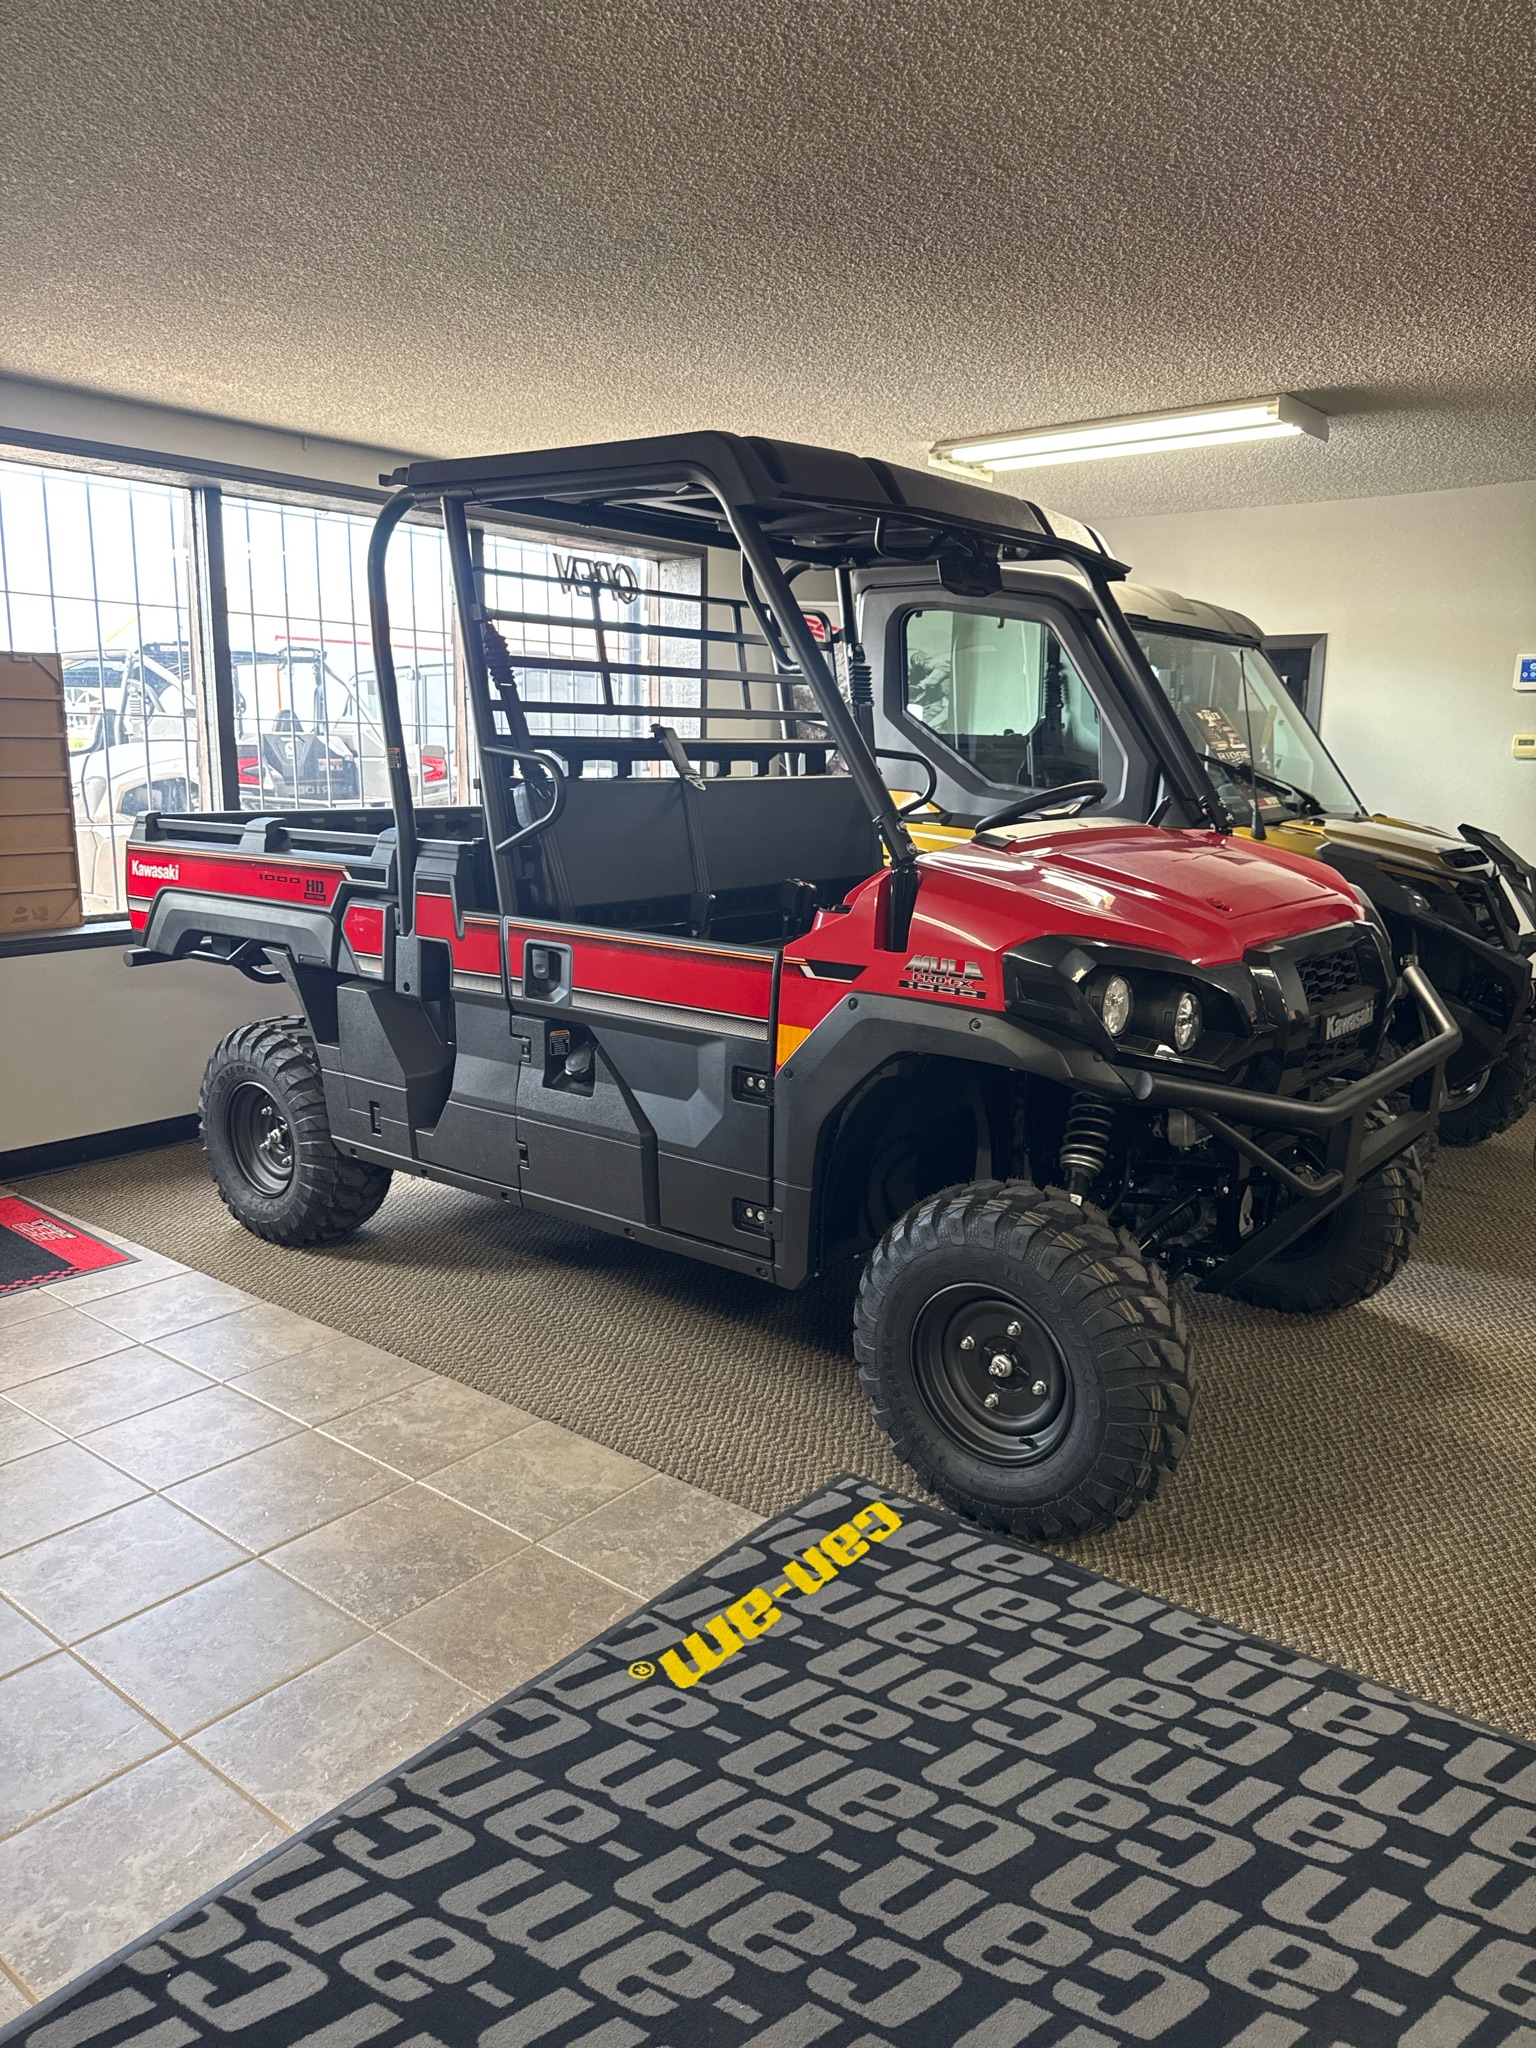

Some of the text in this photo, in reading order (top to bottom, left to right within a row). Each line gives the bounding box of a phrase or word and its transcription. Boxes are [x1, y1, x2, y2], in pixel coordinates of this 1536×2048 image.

[131, 860, 180, 881] Kawasaki
[258, 873, 325, 893] 1000 HD
[903, 954, 985, 981] MULE
[907, 981, 978, 998] 1000
[1326, 1000, 1374, 1040] Kawasaki
